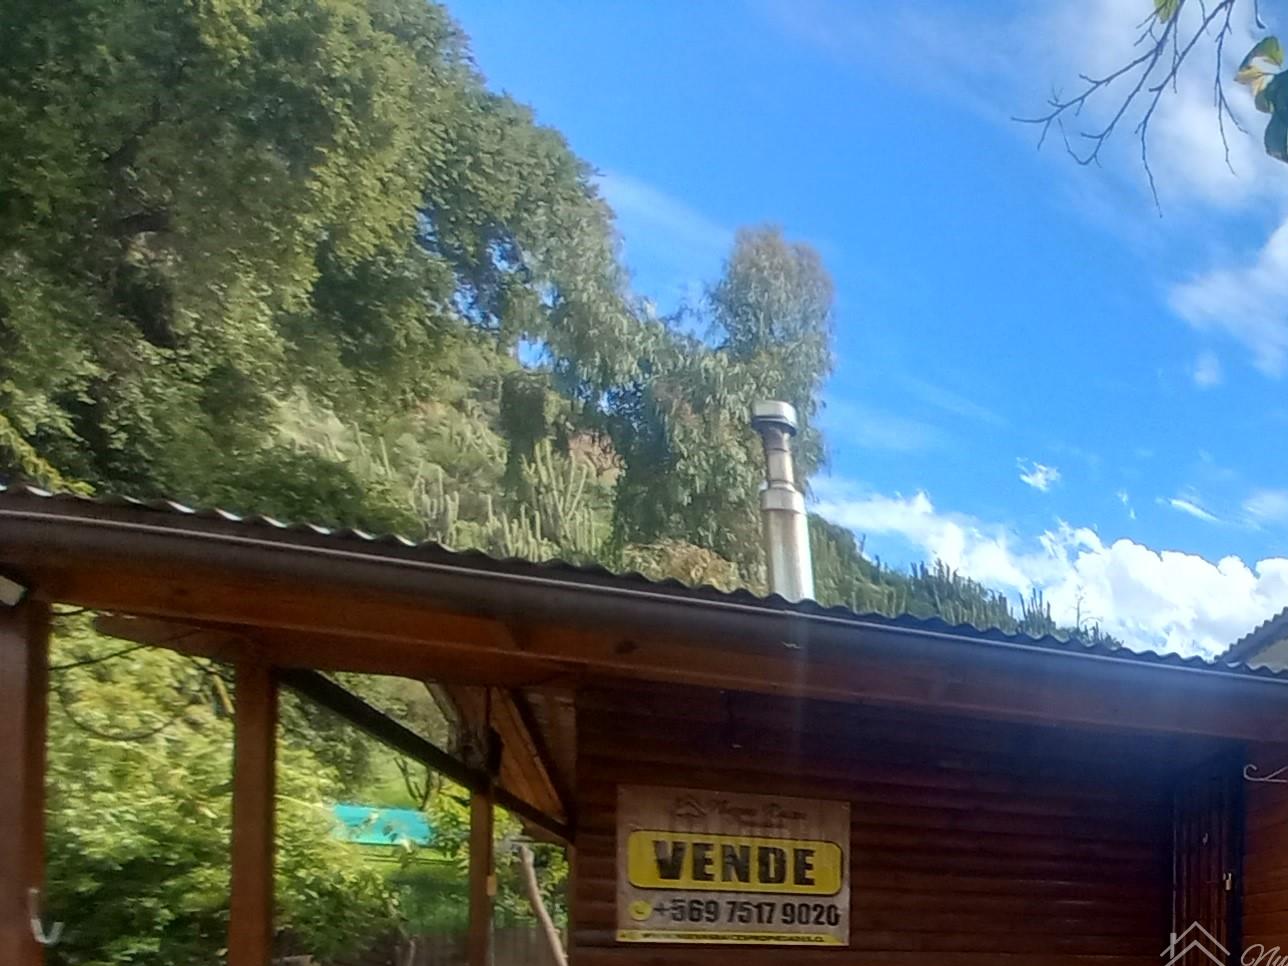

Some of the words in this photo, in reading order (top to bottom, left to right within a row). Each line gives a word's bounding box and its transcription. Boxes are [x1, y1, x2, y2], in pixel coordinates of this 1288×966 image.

[653, 840, 816, 886] VENDE
[653, 899, 720, 923] +569
[727, 900, 777, 924] 7517
[782, 902, 841, 927] 9020
